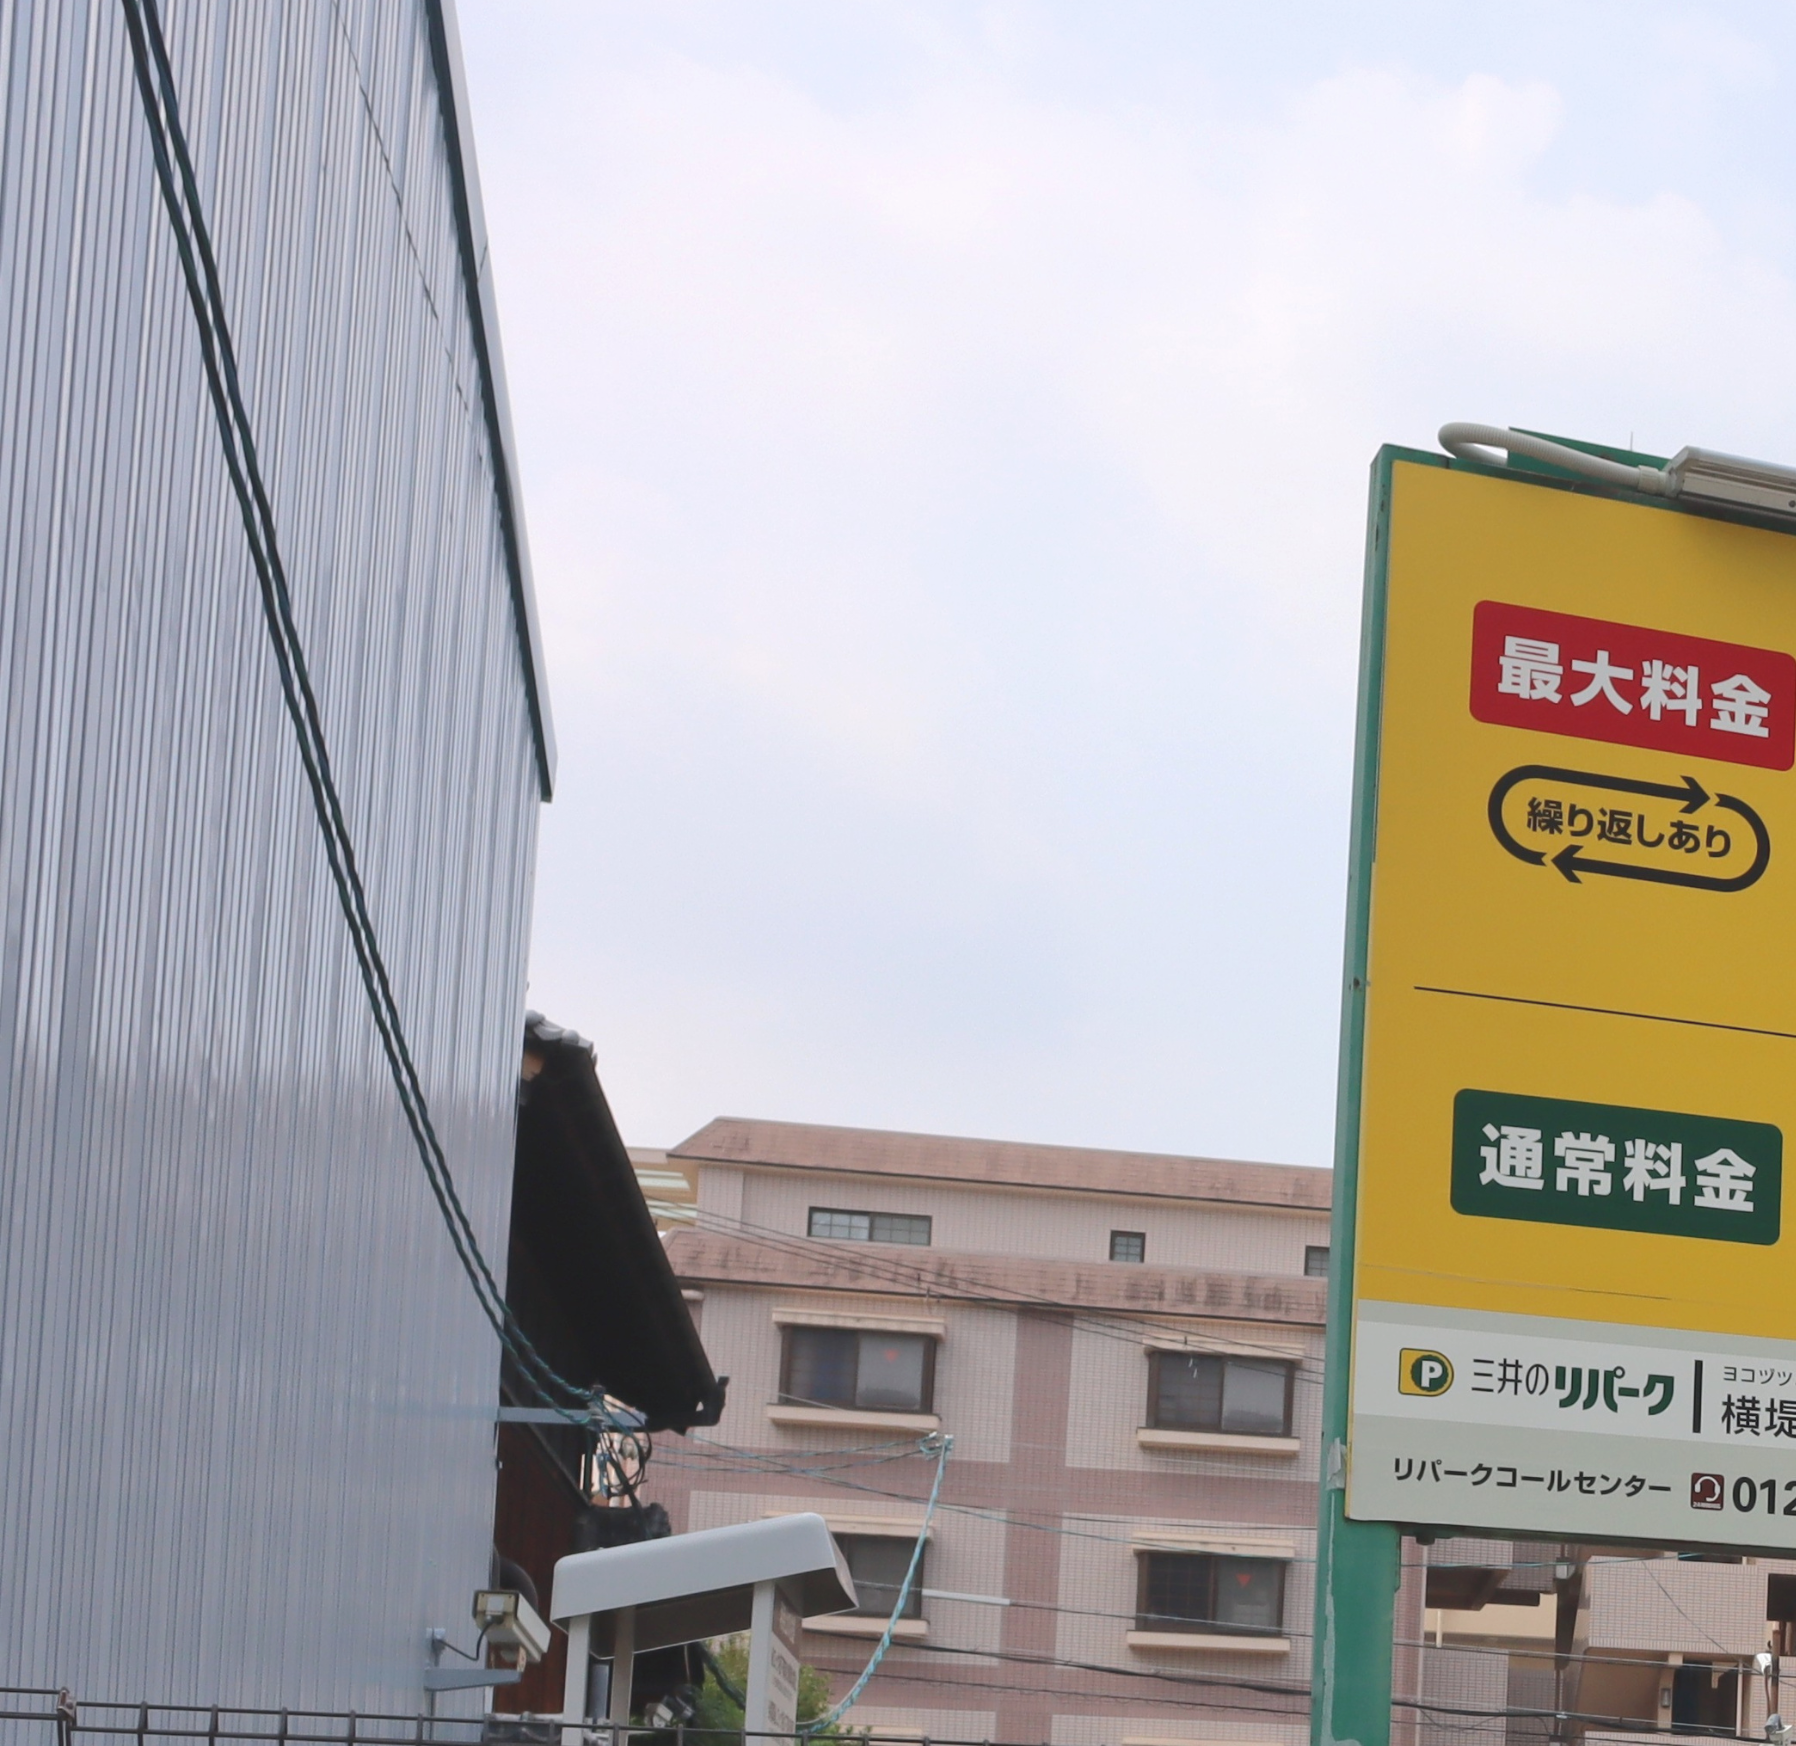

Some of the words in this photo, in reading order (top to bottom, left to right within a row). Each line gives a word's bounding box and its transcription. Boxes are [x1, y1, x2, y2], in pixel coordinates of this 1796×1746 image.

[1497, 636, 1773, 738] 最大料金
[1527, 796, 1731, 859] 繰り返しあり
[1477, 1124, 1757, 1213] 通常料金
[1472, 1357, 1674, 1415] 三井のリパーク
[1393, 1457, 1671, 1494] リパークコールセンター
